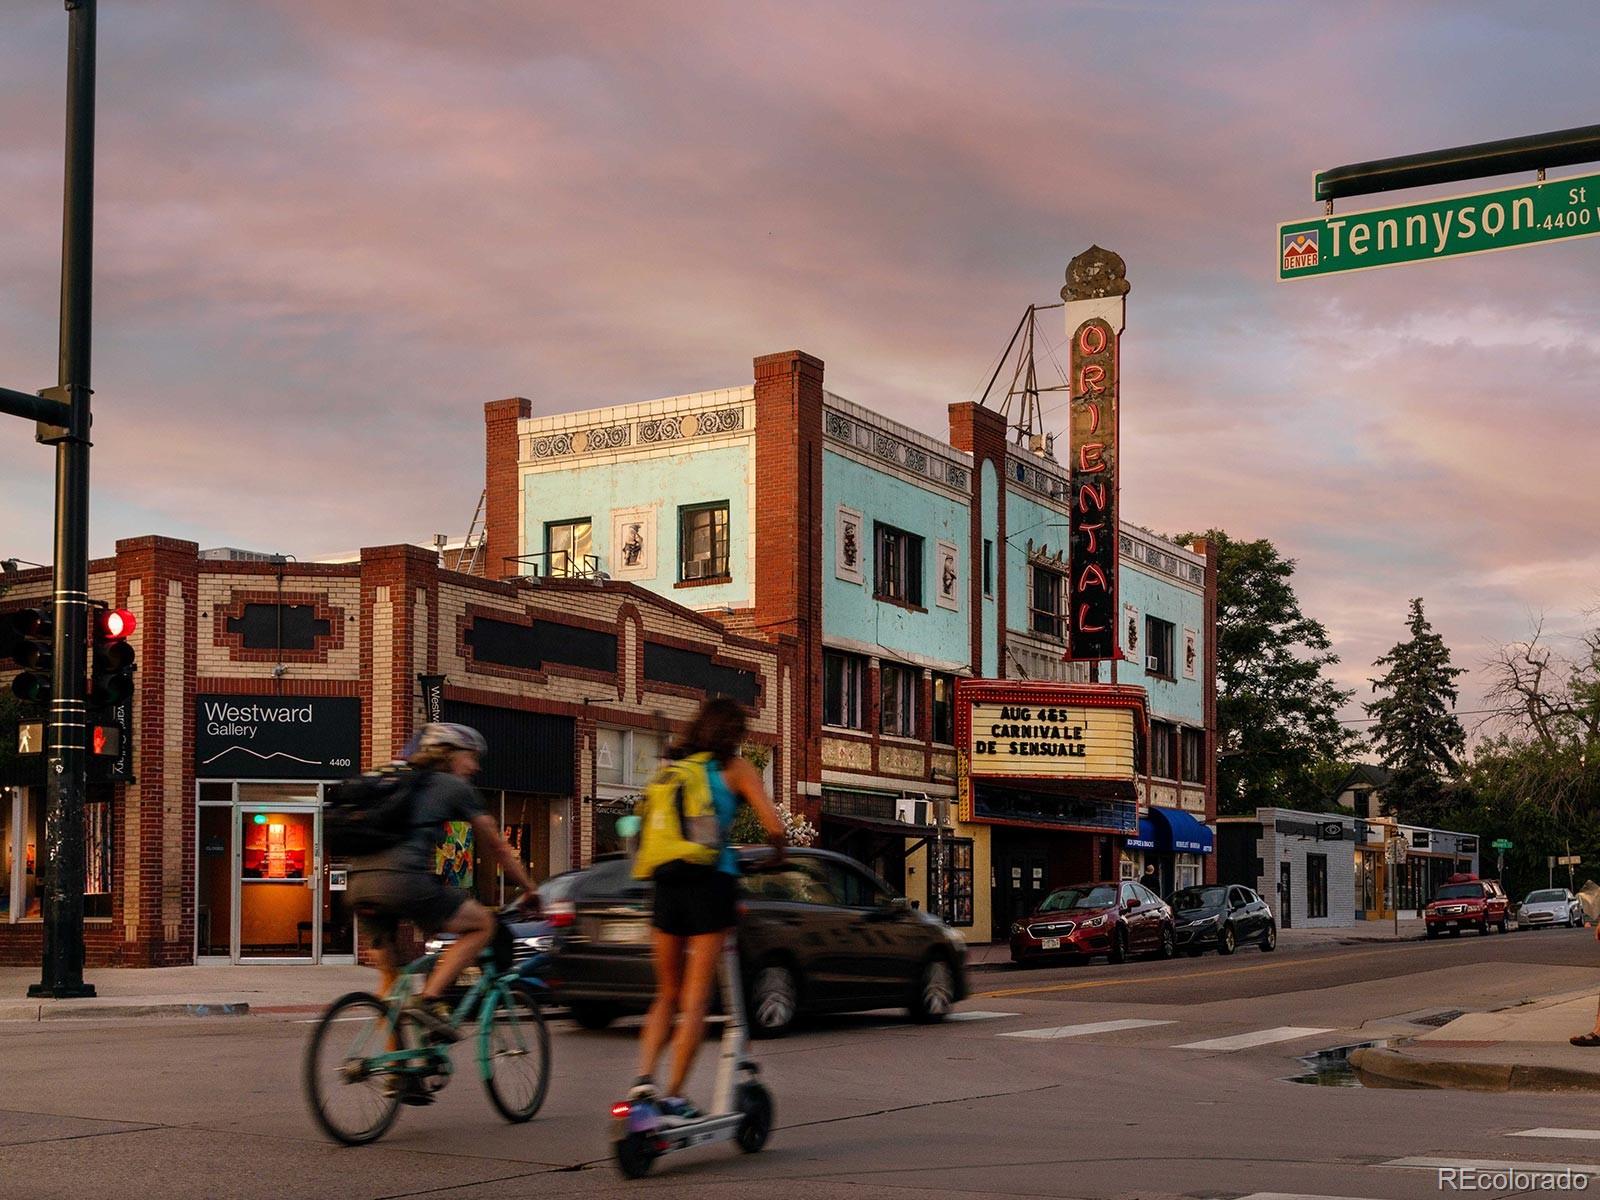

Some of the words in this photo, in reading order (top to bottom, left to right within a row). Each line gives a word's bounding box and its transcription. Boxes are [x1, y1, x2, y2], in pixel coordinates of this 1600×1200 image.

[1327, 196, 1534, 257] Tennyson
[1569, 187, 1586, 205] St
[1543, 208, 1590, 230] 4400
[1284, 253, 1318, 269] DENVER
[1078, 325, 1107, 632] ORIENTAL
[204, 702, 313, 723] Westward
[431, 685, 441, 723] Westw
[1000, 706, 1031, 722] AUG
[1037, 708, 1067, 722] 4&5
[206, 722, 258, 739] Gallery
[991, 724, 1082, 740] CARNIVALE
[976, 741, 997, 755] DE
[1009, 741, 1086, 757] SENSUALE
[329, 758, 351, 767] 4400
